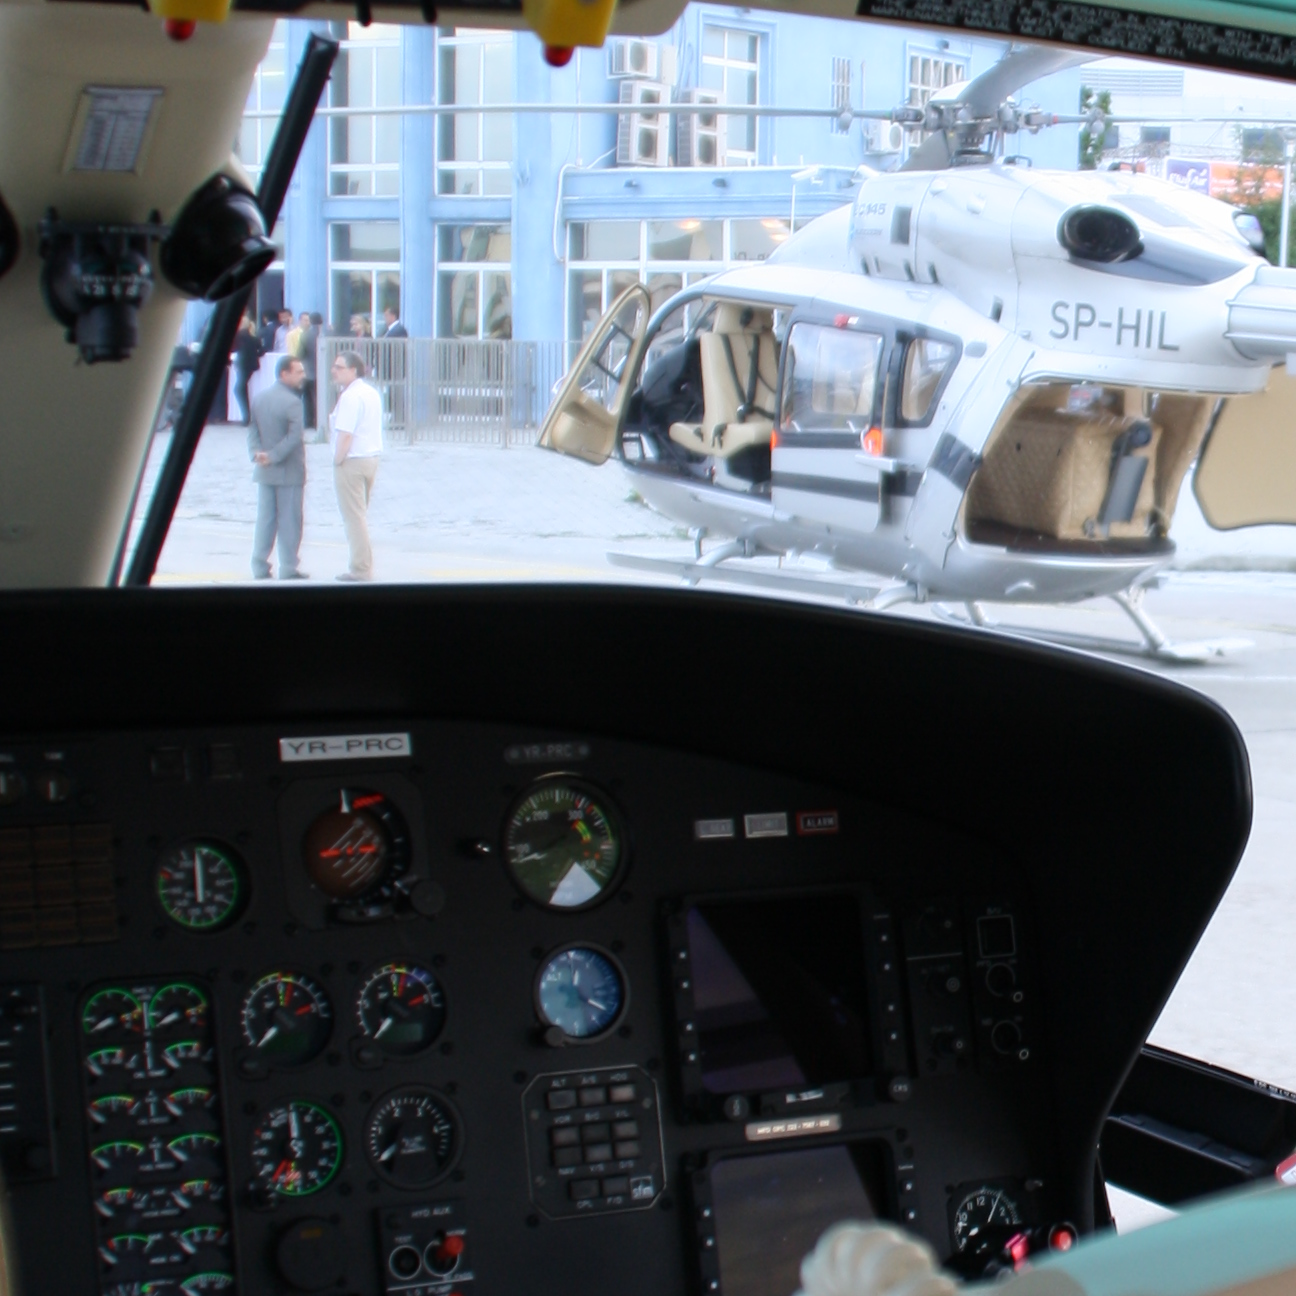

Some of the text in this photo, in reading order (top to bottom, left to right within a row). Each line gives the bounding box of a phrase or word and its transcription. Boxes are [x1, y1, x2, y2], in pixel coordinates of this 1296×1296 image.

[1049, 300, 1180, 352] SP-HIL
[288, 737, 404, 754] YR-PRC
[805, 816, 835, 829] ALARM
